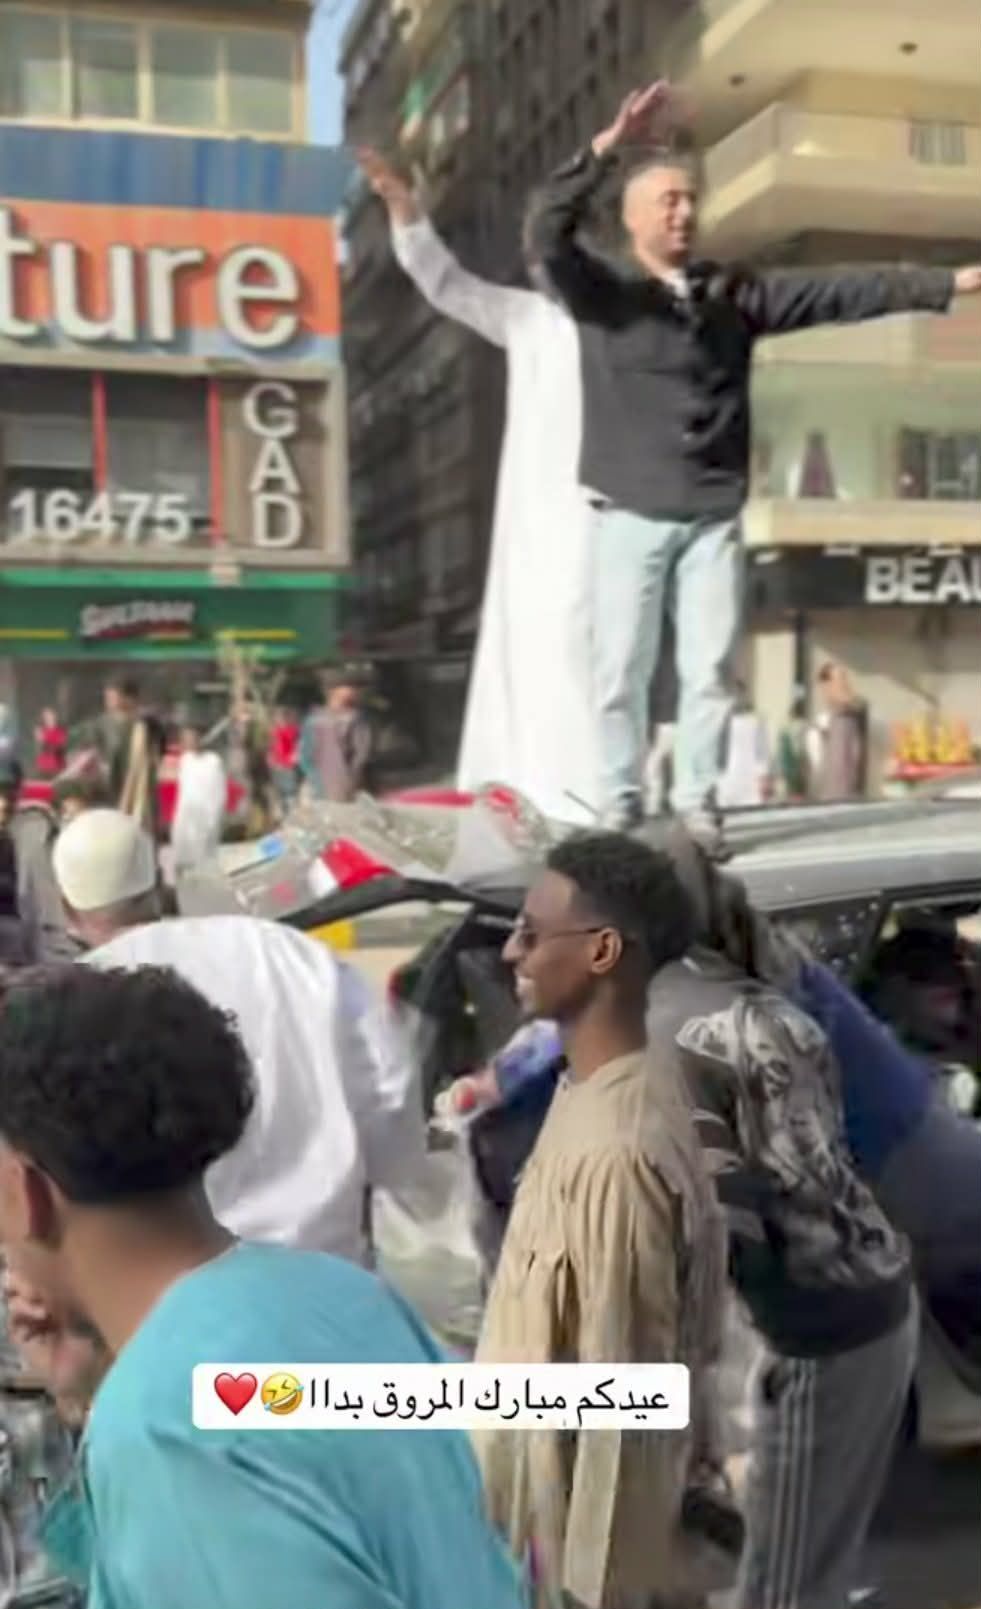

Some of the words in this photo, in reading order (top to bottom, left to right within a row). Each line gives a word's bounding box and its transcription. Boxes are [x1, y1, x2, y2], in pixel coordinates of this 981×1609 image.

[0, 206, 299, 347] ture
[9, 487, 191, 545] 16475
[243, 382, 302, 548] GAD
